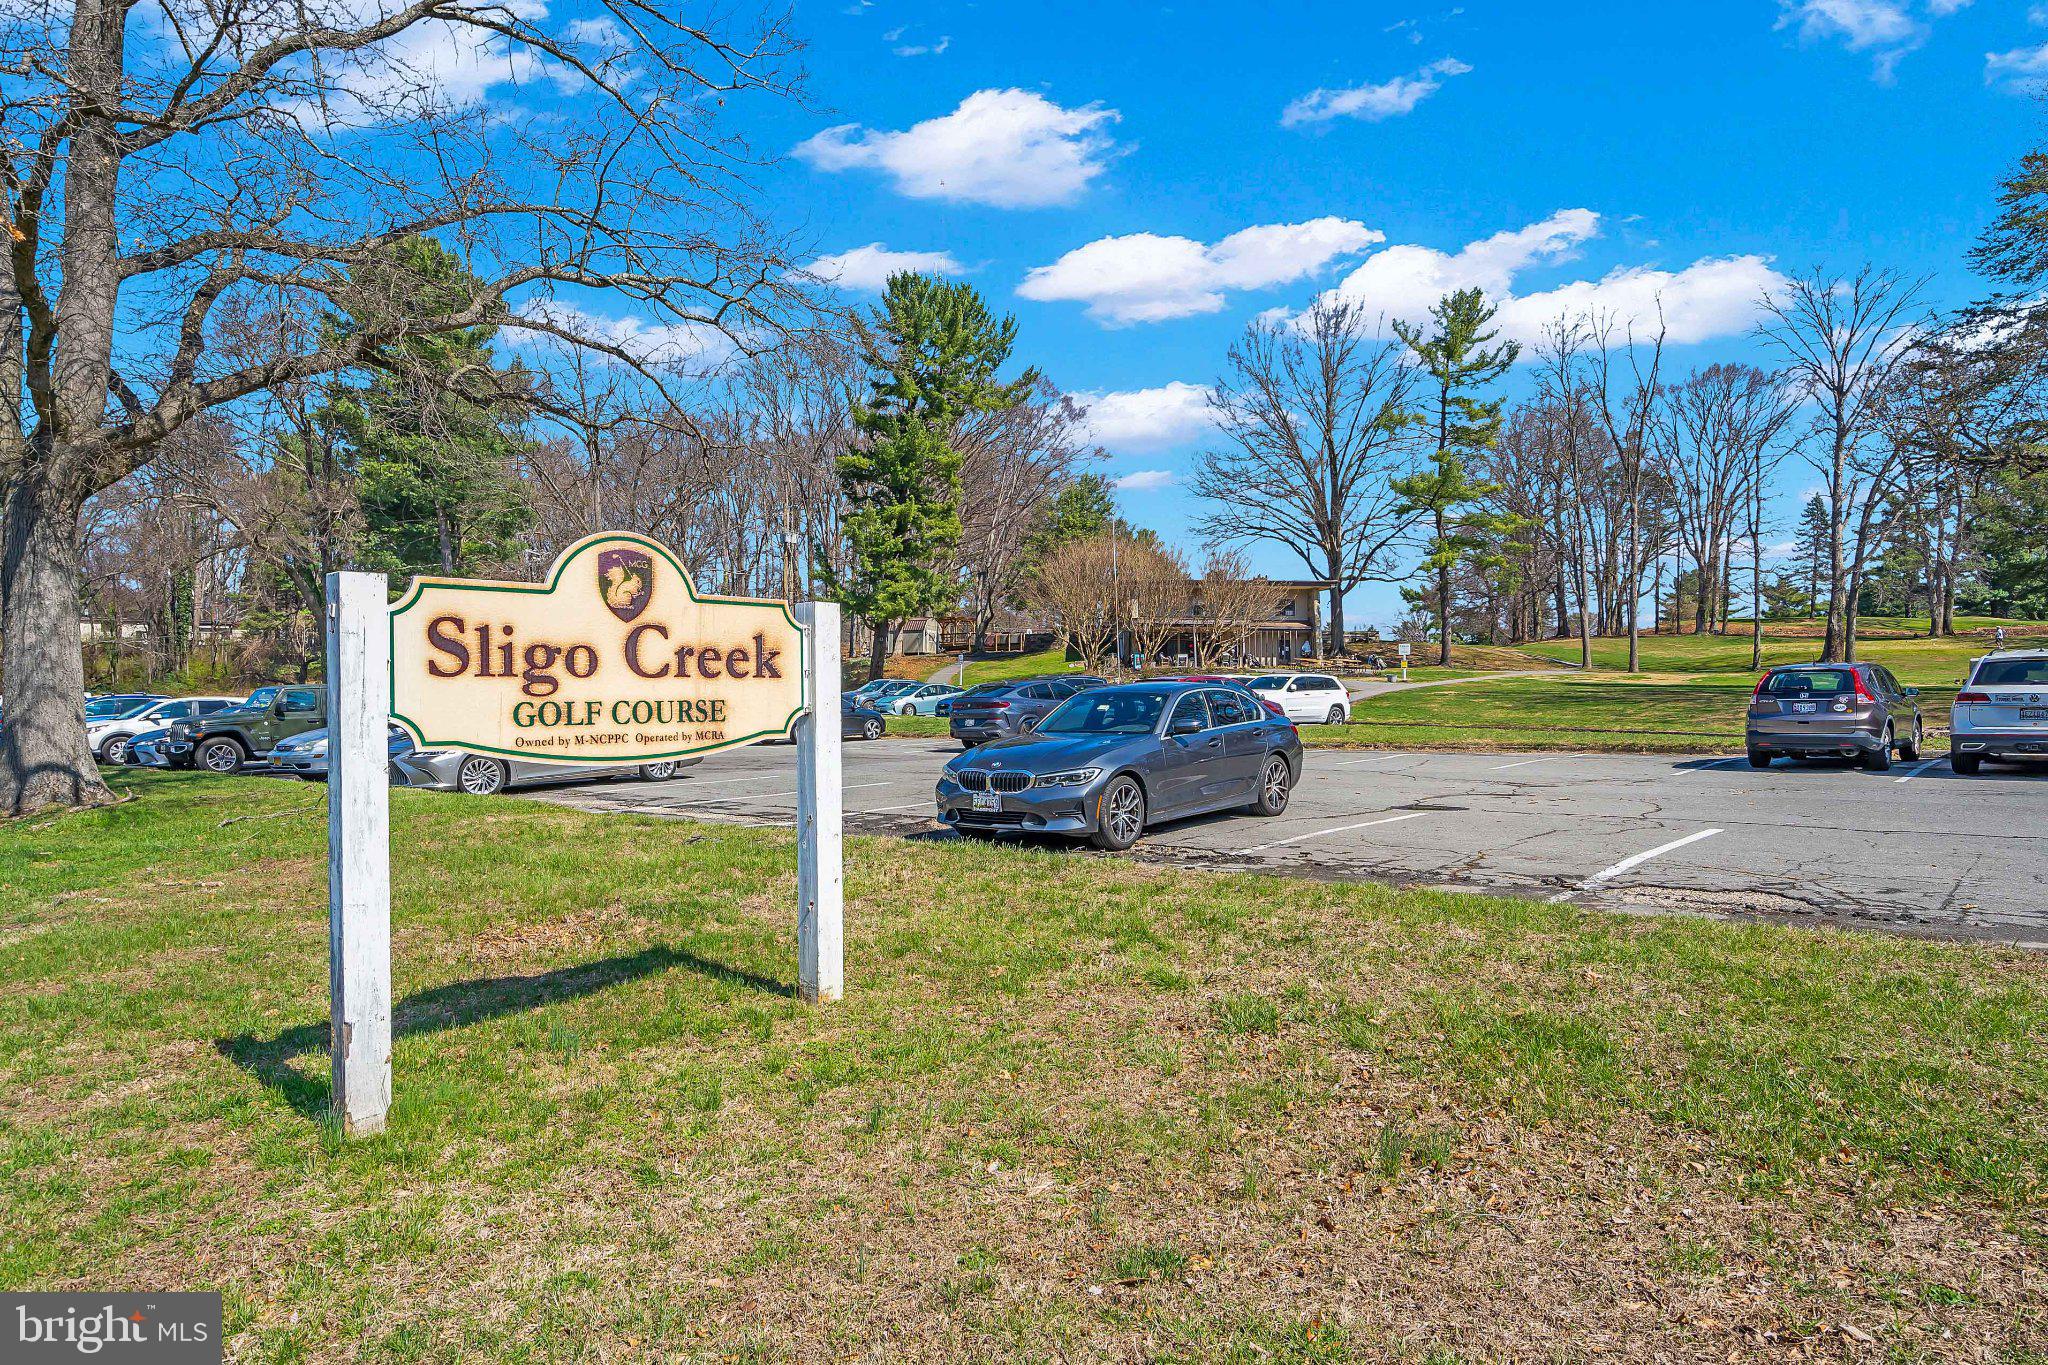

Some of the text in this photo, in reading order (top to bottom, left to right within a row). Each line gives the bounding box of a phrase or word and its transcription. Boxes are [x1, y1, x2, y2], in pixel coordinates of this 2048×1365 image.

[628, 560, 648, 569] MCG
[427, 616, 782, 697] Sligo Creek
[513, 699, 726, 727] GOLF COURSE
[515, 730, 725, 748] Owned by M-NCPPC Operated by MCRA
